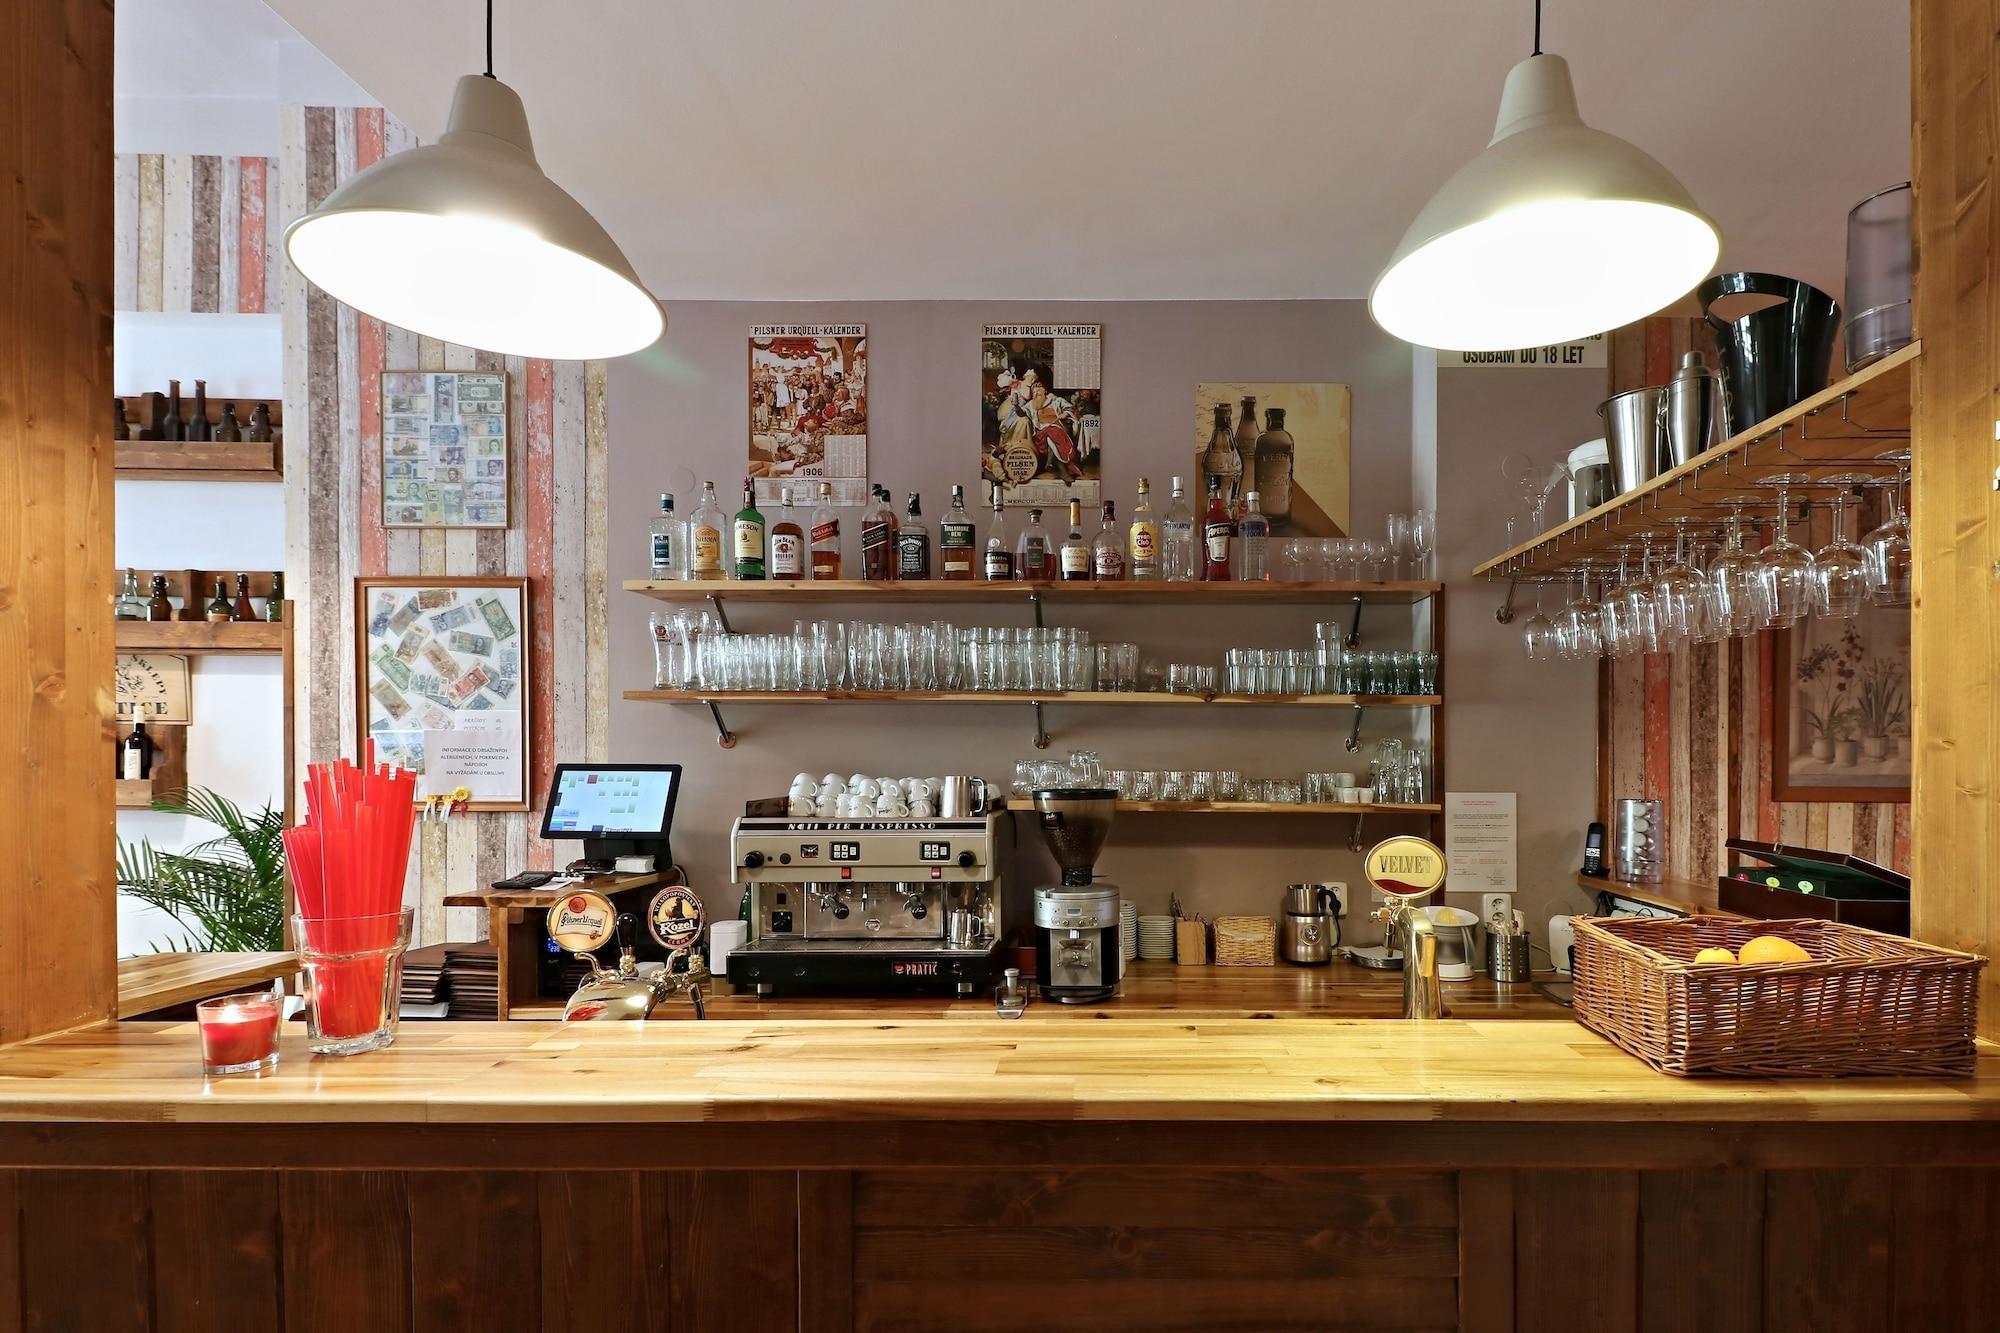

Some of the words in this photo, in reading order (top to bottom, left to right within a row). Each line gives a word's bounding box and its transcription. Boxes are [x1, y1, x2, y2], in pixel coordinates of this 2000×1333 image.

[754, 326, 786, 335] PILSNER
[985, 326, 1018, 335] PILSNER
[1543, 346, 1558, 364] 18
[1563, 346, 1584, 364] LET
[1082, 419, 1099, 428] 1892
[802, 468, 823, 476] 1906
[115, 701, 168, 715] TICE
[1379, 855, 1432, 874] VELVET
[660, 919, 694, 935] Kozel
[906, 963, 938, 976] PRATIC
